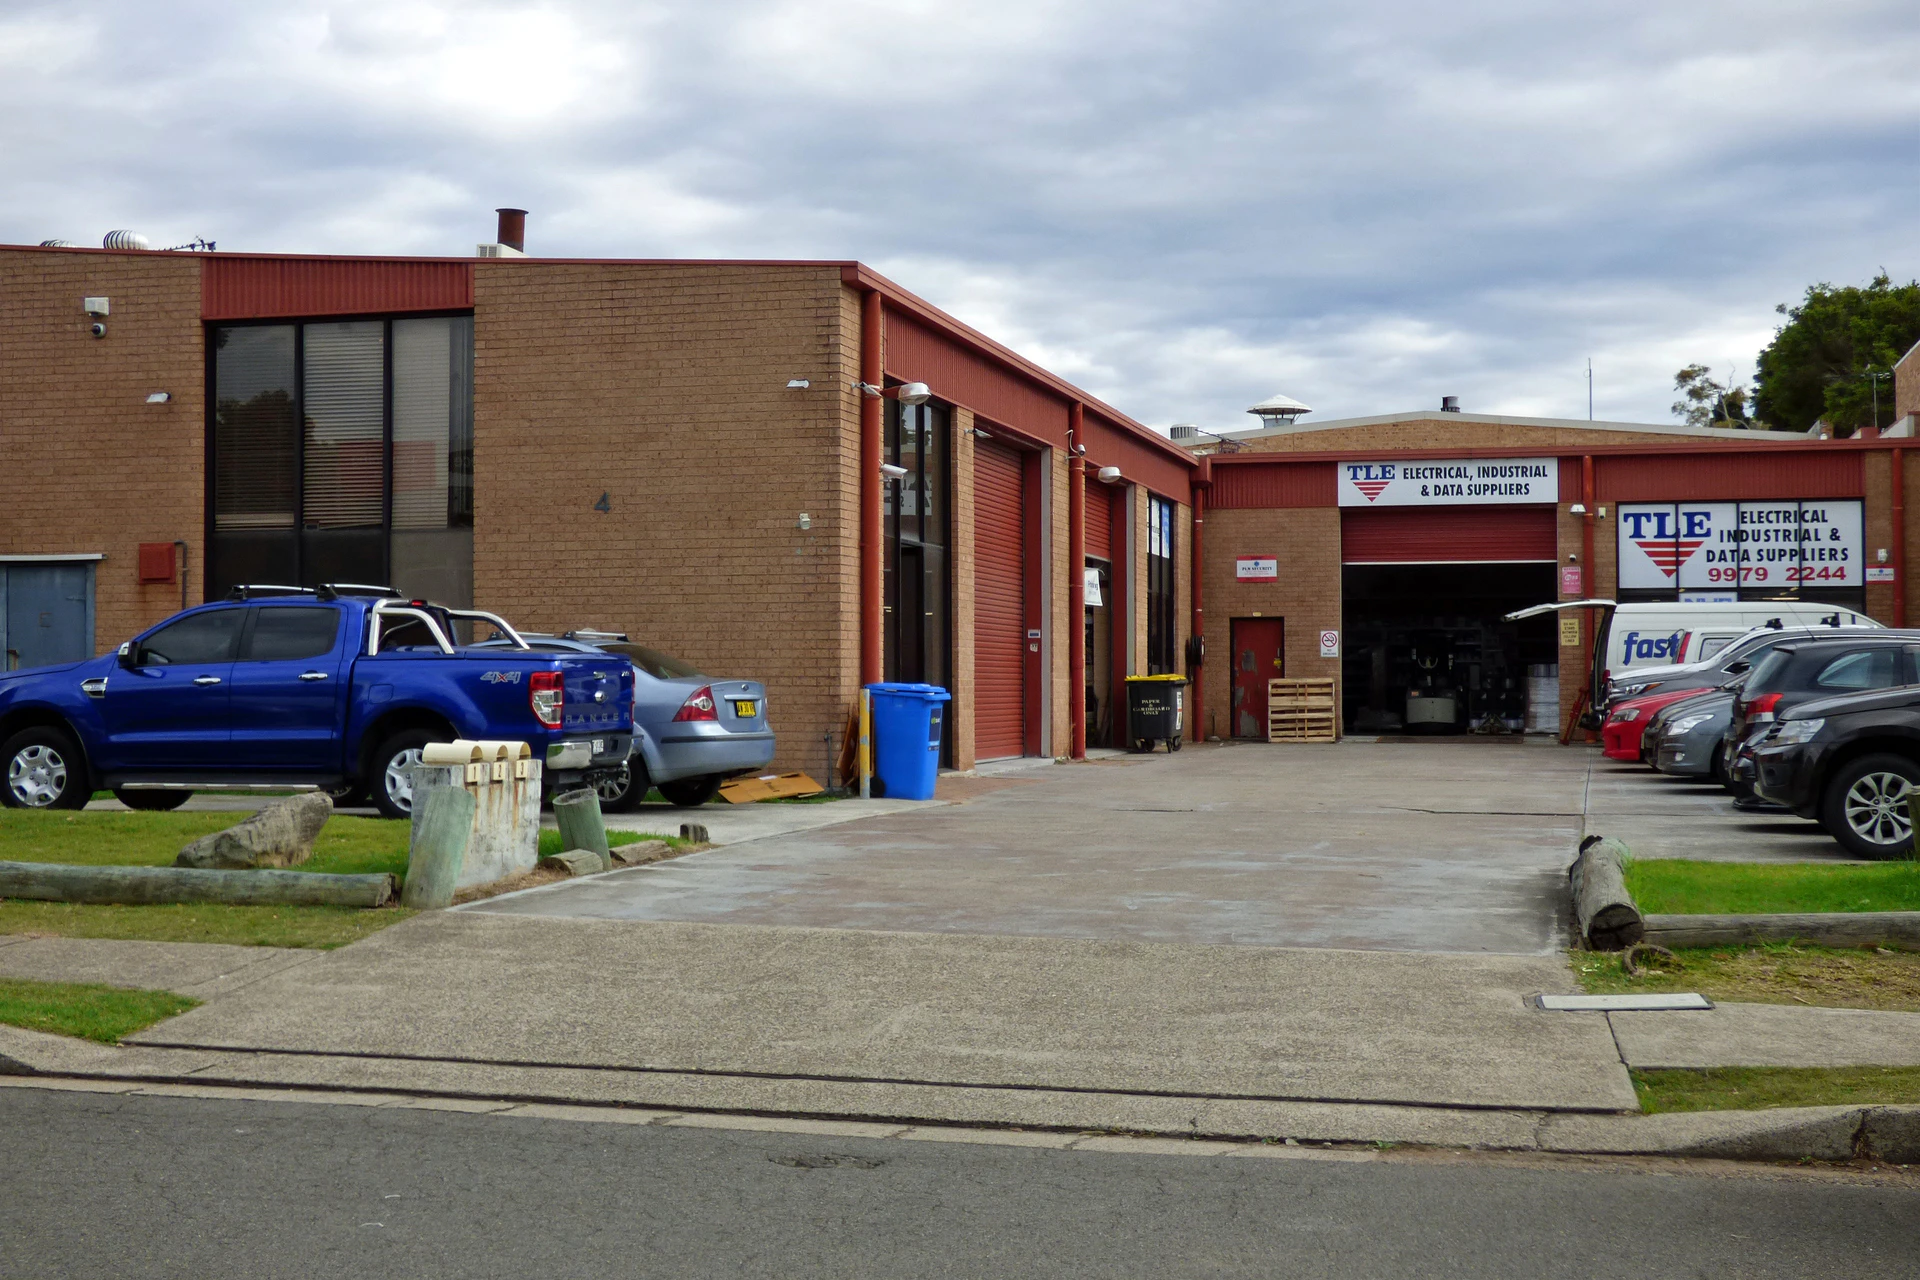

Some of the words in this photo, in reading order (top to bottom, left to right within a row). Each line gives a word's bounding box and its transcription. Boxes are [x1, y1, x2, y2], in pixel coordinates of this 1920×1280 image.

[1347, 464, 1395, 480] TLE
[1403, 466, 1473, 481] ELECTRICAL,
[1477, 465, 1548, 479] INDUSTRIAL
[1420, 484, 1430, 497] &
[1434, 484, 1464, 496] DATA
[1467, 483, 1530, 496] SUPPLIERS
[594, 491, 610, 513] 4
[1740, 510, 1828, 524] ELECTRICAL
[1623, 511, 1712, 539] TLE
[1719, 529, 1821, 543] INDUSTRIAL
[1829, 528, 1841, 541] &
[1706, 549, 1751, 563] DATA
[1756, 548, 1849, 562] SUPPLIERS
[1708, 567, 1769, 582] 9979
[1785, 566, 1847, 581] 2244
[565, 713, 630, 725] RANGER
